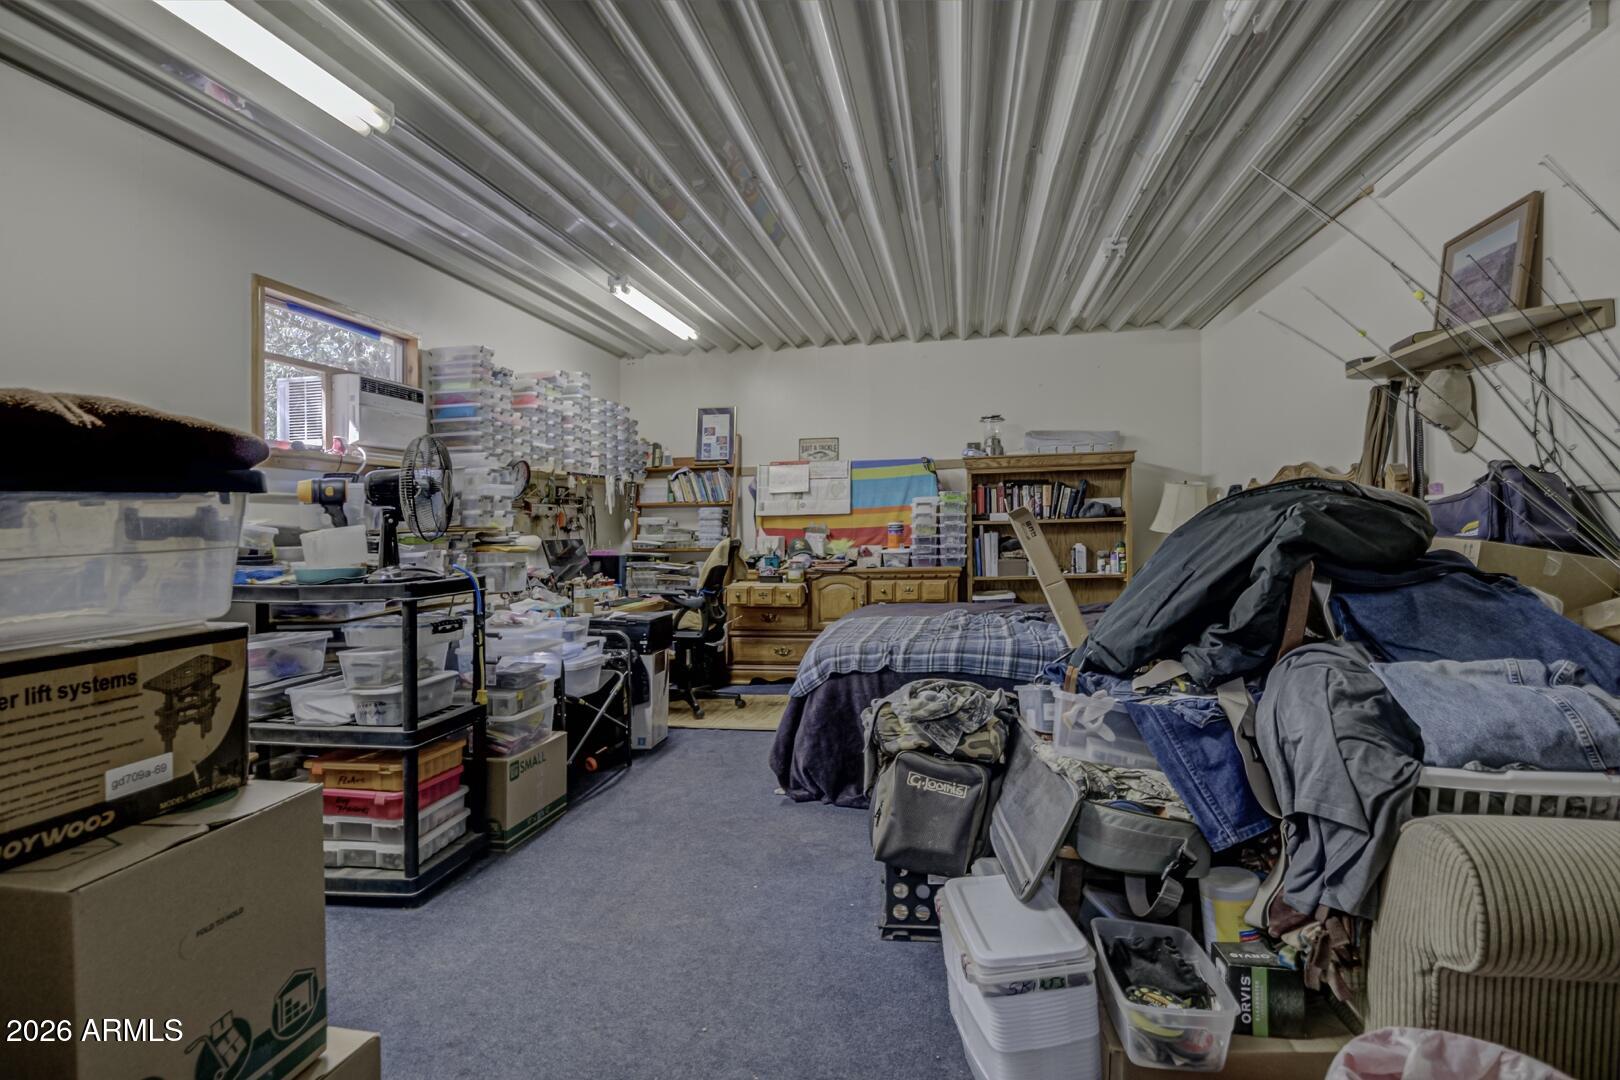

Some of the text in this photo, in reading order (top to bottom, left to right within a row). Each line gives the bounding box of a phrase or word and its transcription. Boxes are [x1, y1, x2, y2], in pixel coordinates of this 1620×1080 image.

[24, 684, 53, 706] lift
[57, 672, 138, 702] systems
[519, 751, 547, 774] SMALL
[1240, 975, 1252, 1024] ORVIS
